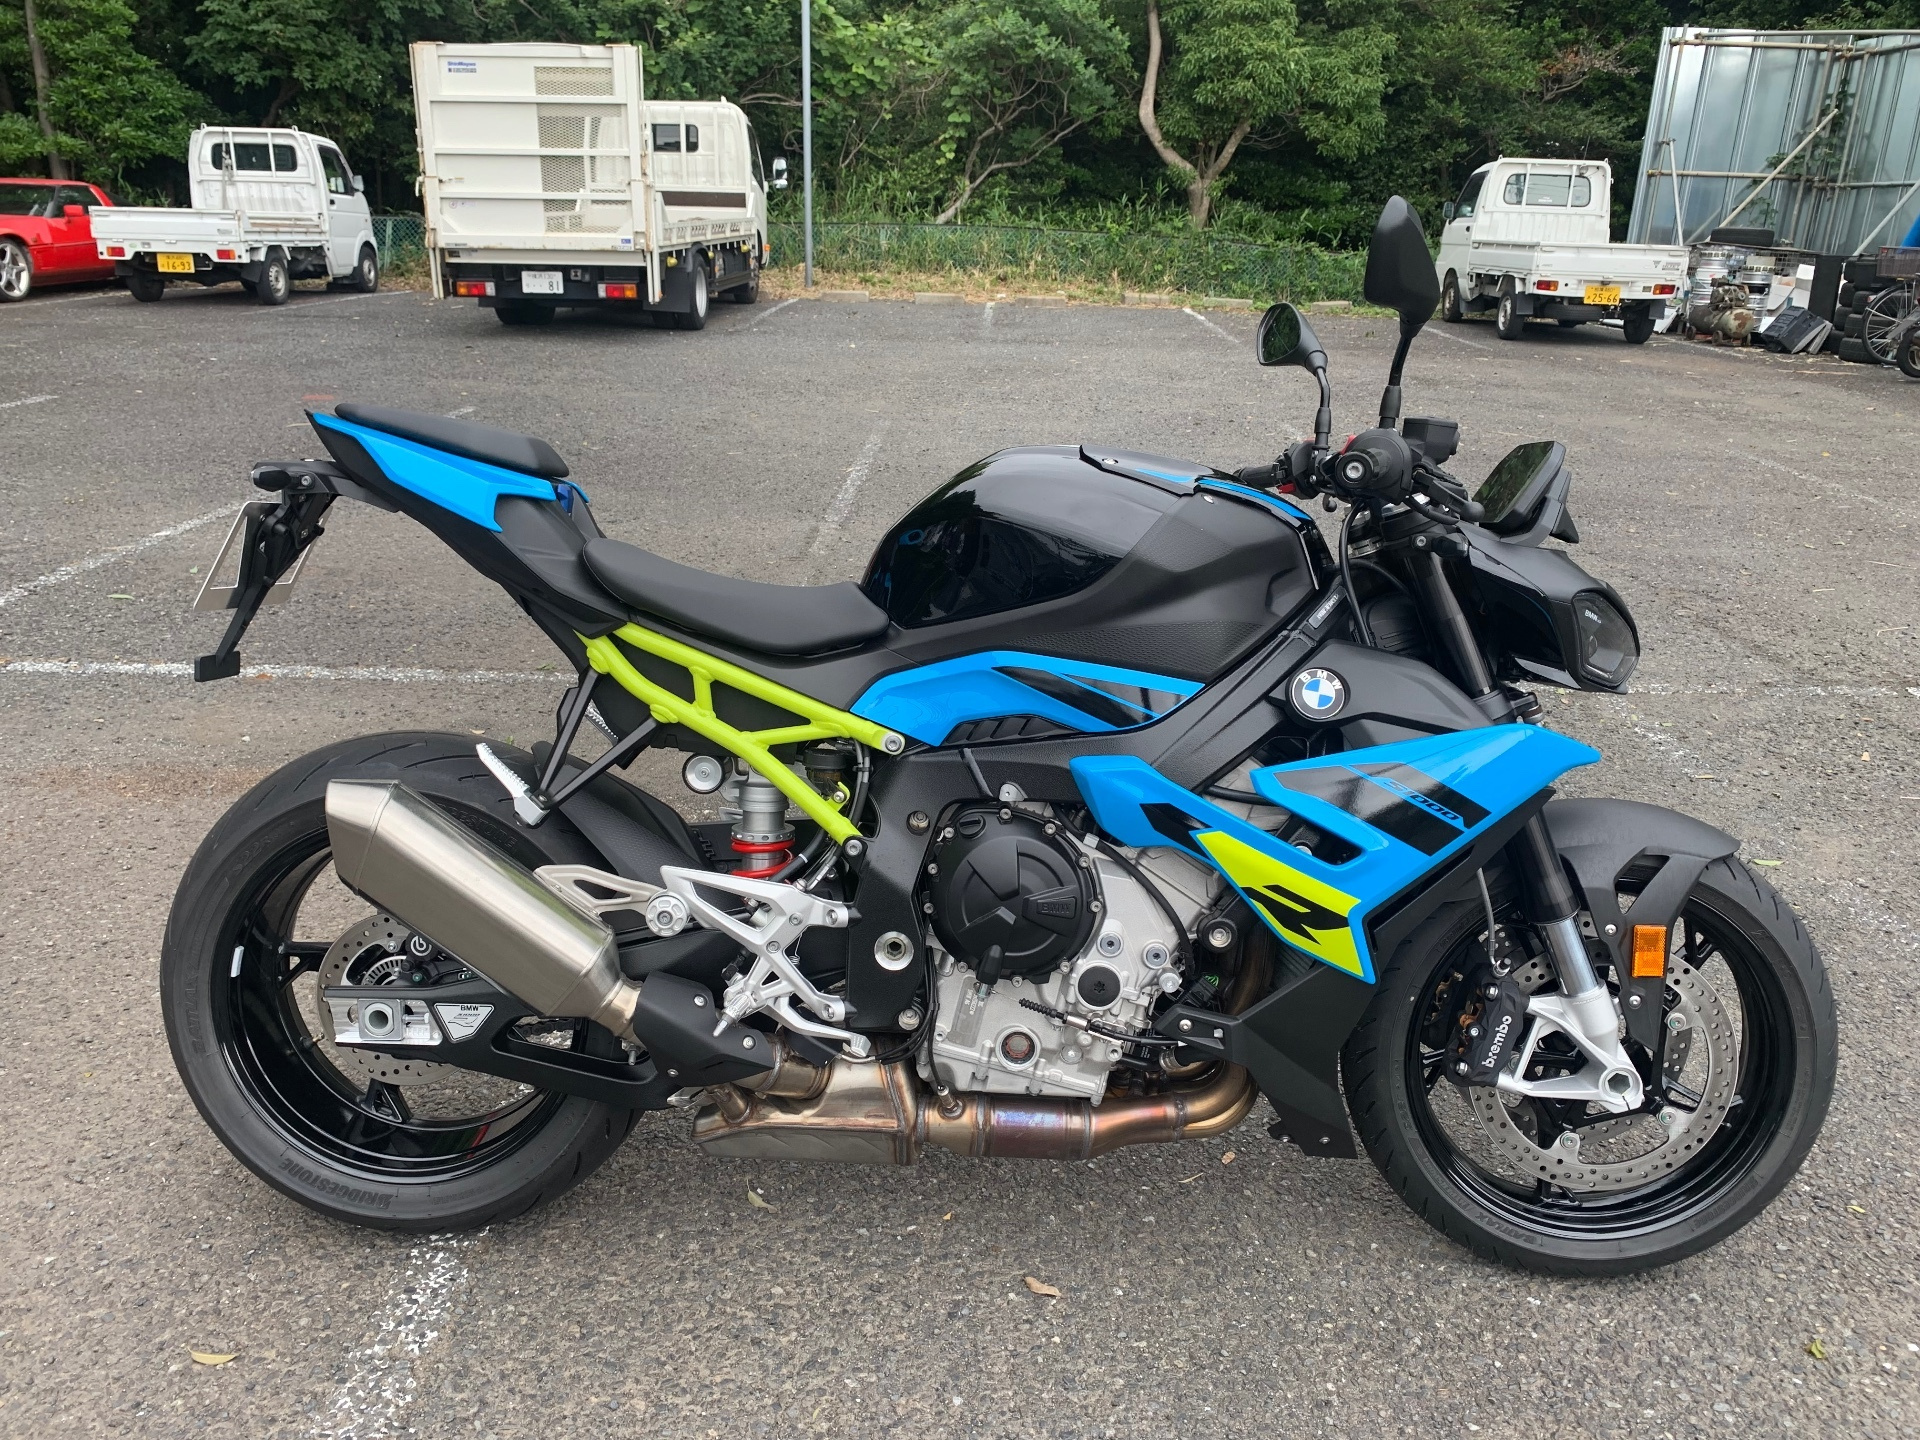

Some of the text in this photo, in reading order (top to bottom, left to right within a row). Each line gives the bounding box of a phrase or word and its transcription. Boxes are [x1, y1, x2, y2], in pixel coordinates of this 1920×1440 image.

[1299, 669, 1343, 691] BMW
[1041, 902, 1071, 914] BMW
[460, 1004, 479, 1012] BMW
[1481, 1015, 1513, 1068] brembo
[278, 1157, 395, 1210] BRIDGESTONE
